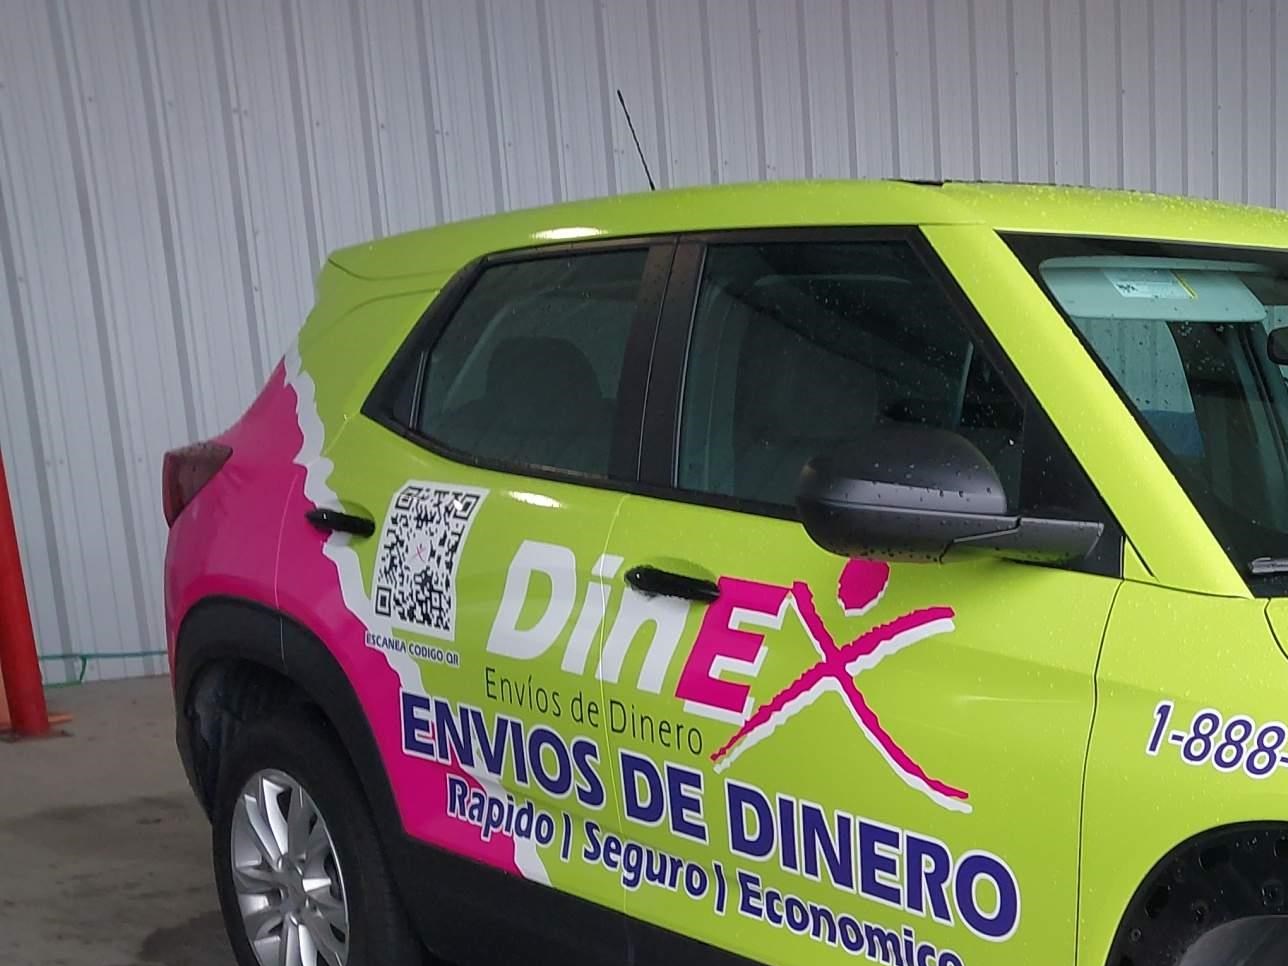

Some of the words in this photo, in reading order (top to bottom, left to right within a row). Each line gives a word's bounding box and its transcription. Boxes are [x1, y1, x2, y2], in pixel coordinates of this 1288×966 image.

[366, 633, 407, 653] ESCANEA
[409, 643, 444, 662] CODIGO
[446, 652, 459, 666] QR
[484, 666, 562, 720] Envíos
[570, 694, 601, 729] de
[610, 701, 704, 756] Dinero
[402, 692, 605, 807] ENVIOS
[621, 751, 708, 843] DE
[728, 781, 1020, 941] DINERO
[447, 775, 556, 846] Rapido
[584, 822, 709, 898] Seguro
